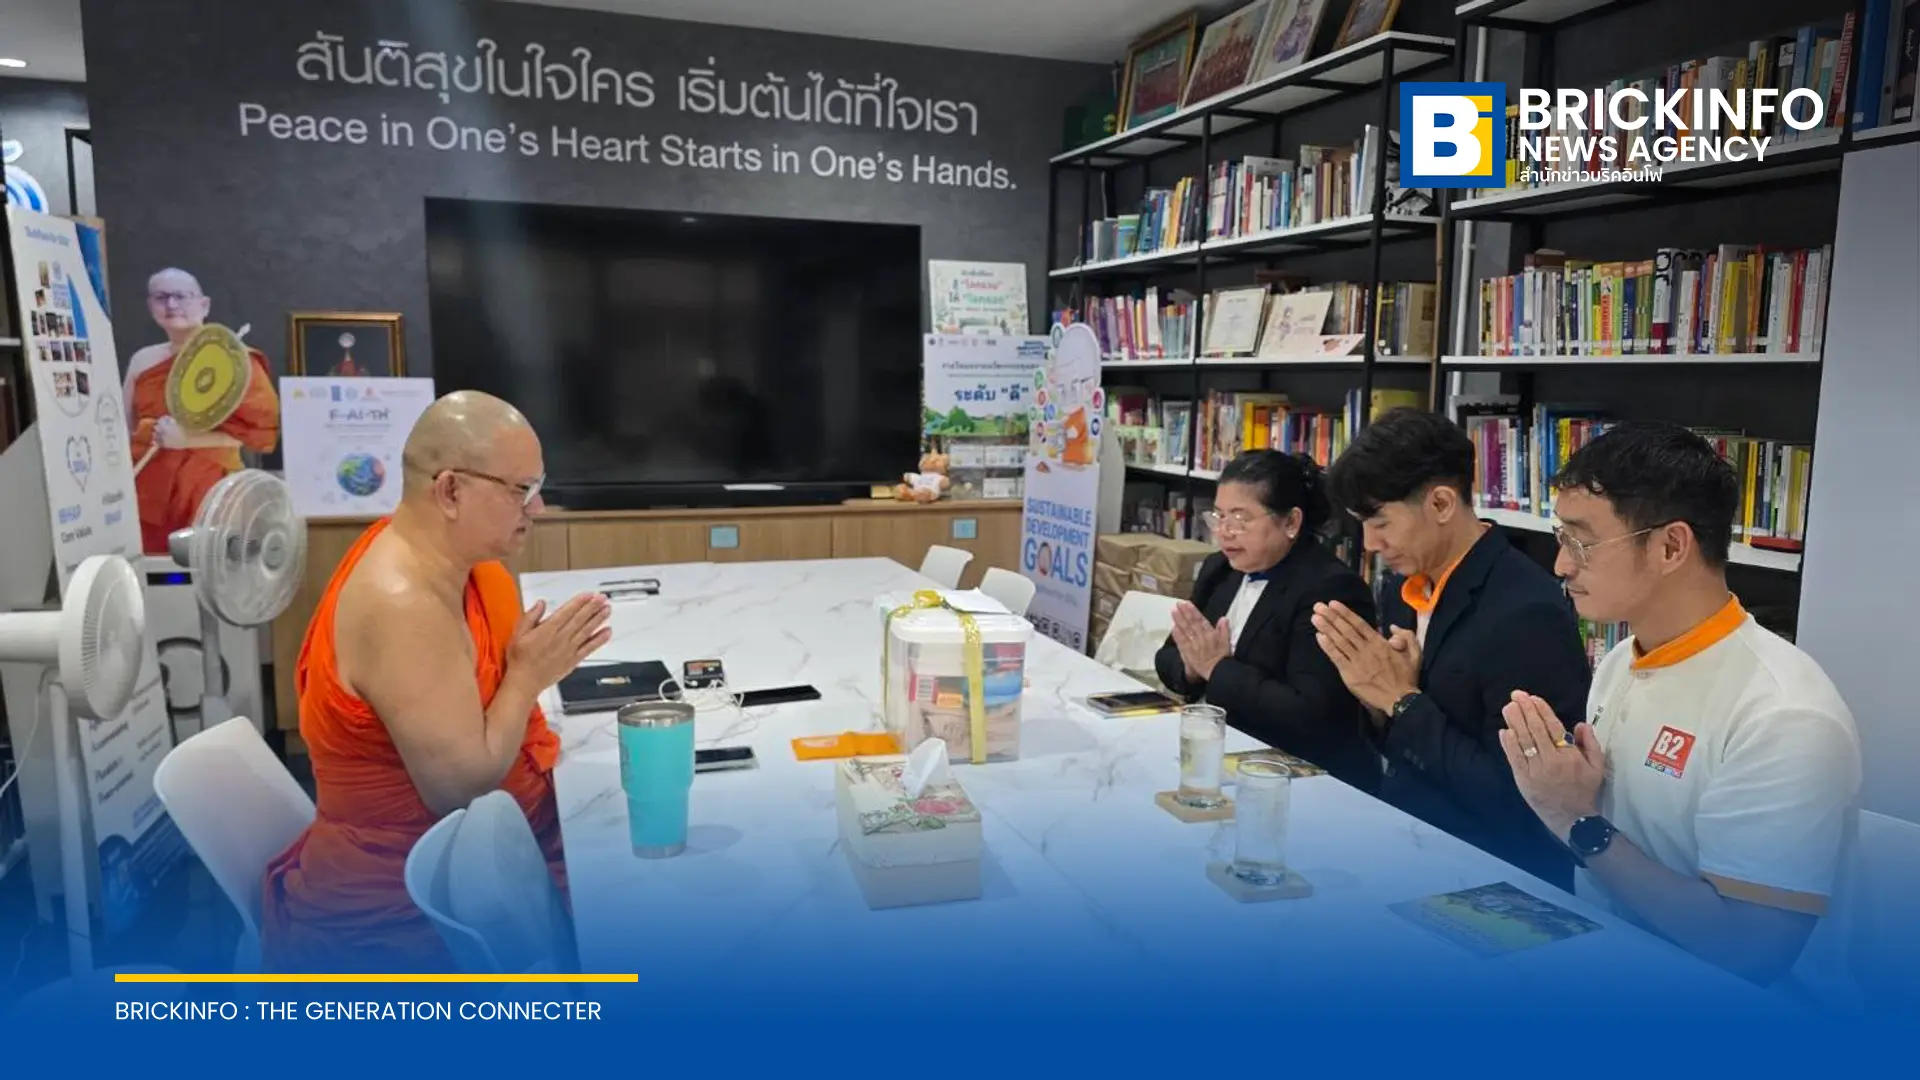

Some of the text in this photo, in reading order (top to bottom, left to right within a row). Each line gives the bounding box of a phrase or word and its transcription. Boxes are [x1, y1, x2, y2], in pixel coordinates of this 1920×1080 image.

[296, 31, 978, 136] สันติสุขในใจใคร เริ่มต้นได้ที่ใจเรา
[239, 102, 1017, 190] Peace in One’s Heart Starts in One’s Hands.
[954, 383, 997, 402] ระดับ
[1027, 496, 1092, 528] SUSTAINABLE
[1026, 518, 1091, 550] DEVELOPMENT
[1024, 537, 1089, 588] GOALS
[1653, 730, 1685, 761] B2
